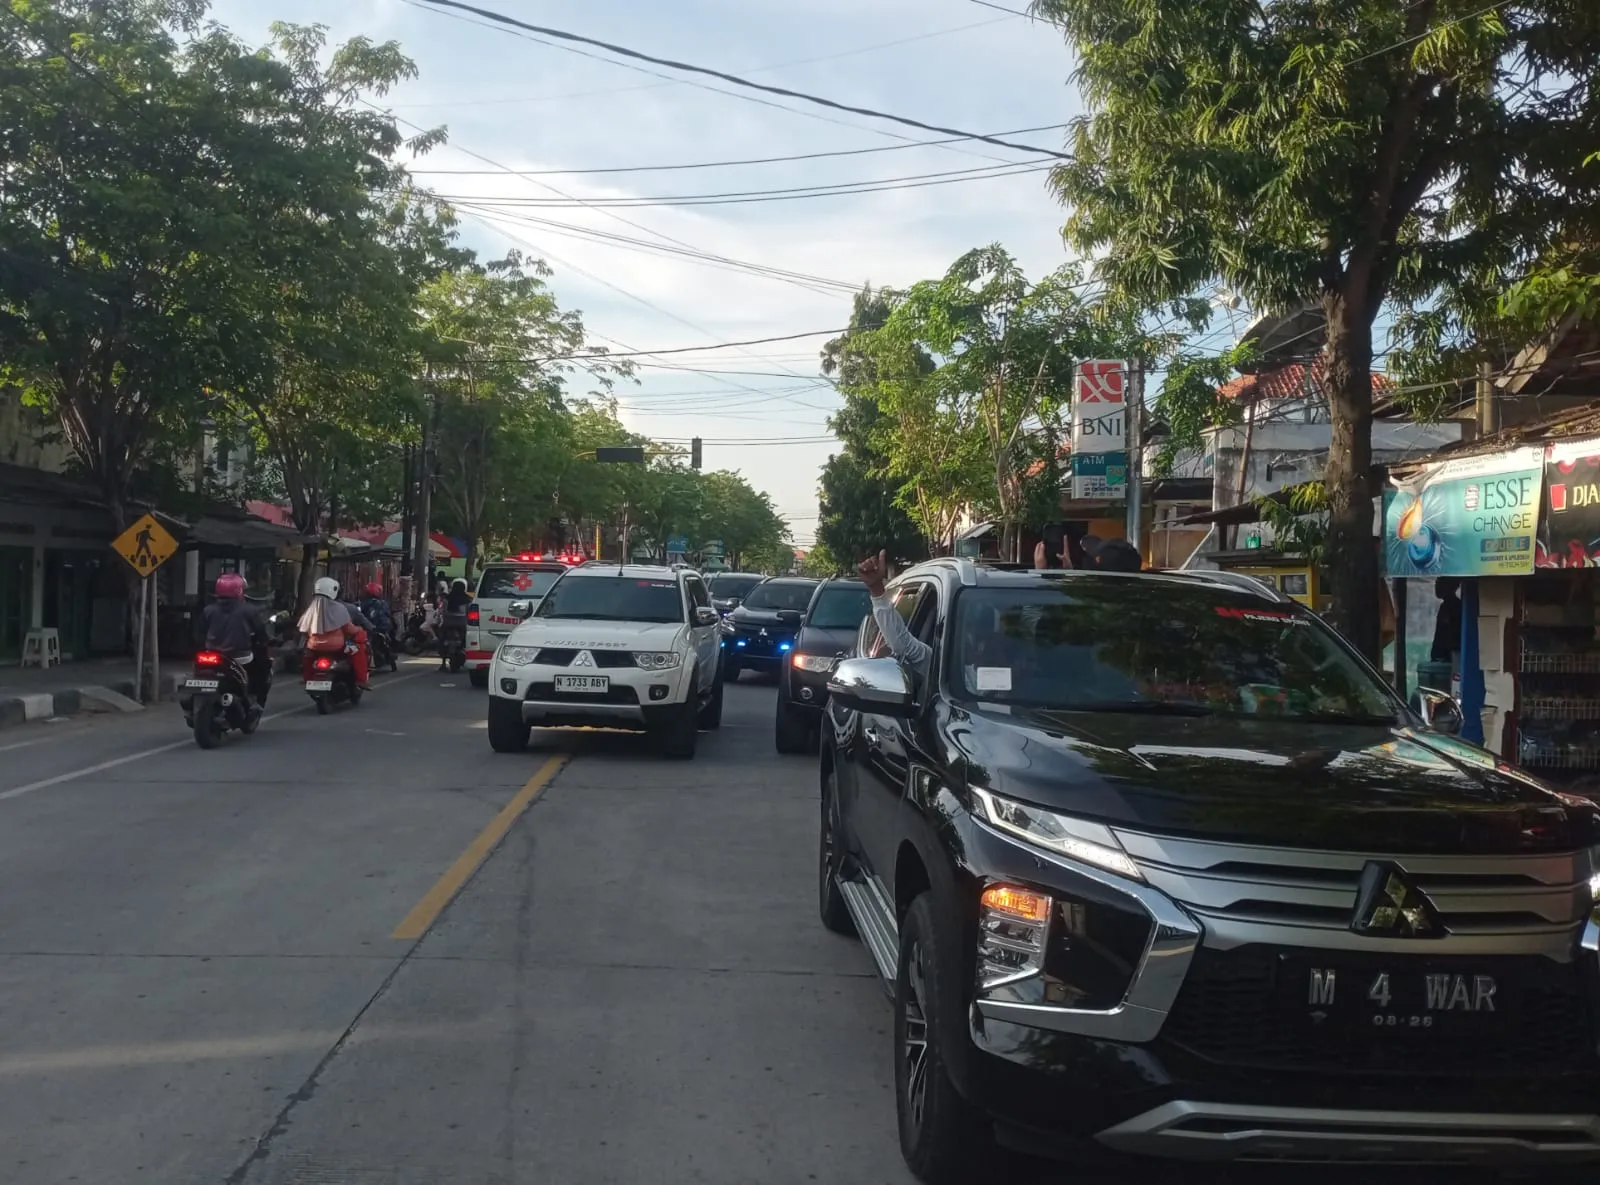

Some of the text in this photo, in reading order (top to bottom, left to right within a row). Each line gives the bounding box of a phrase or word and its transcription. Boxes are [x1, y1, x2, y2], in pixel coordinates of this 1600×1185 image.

[1082, 418, 1121, 436] BNI
[1082, 456, 1105, 465] ATM
[1484, 477, 1532, 510] ESSE
[1572, 484, 1600, 507] DJA
[1473, 513, 1532, 535] CHANGE
[556, 678, 607, 688] N 1733 ABY
[1309, 968, 1497, 1011] M 4 WAR
